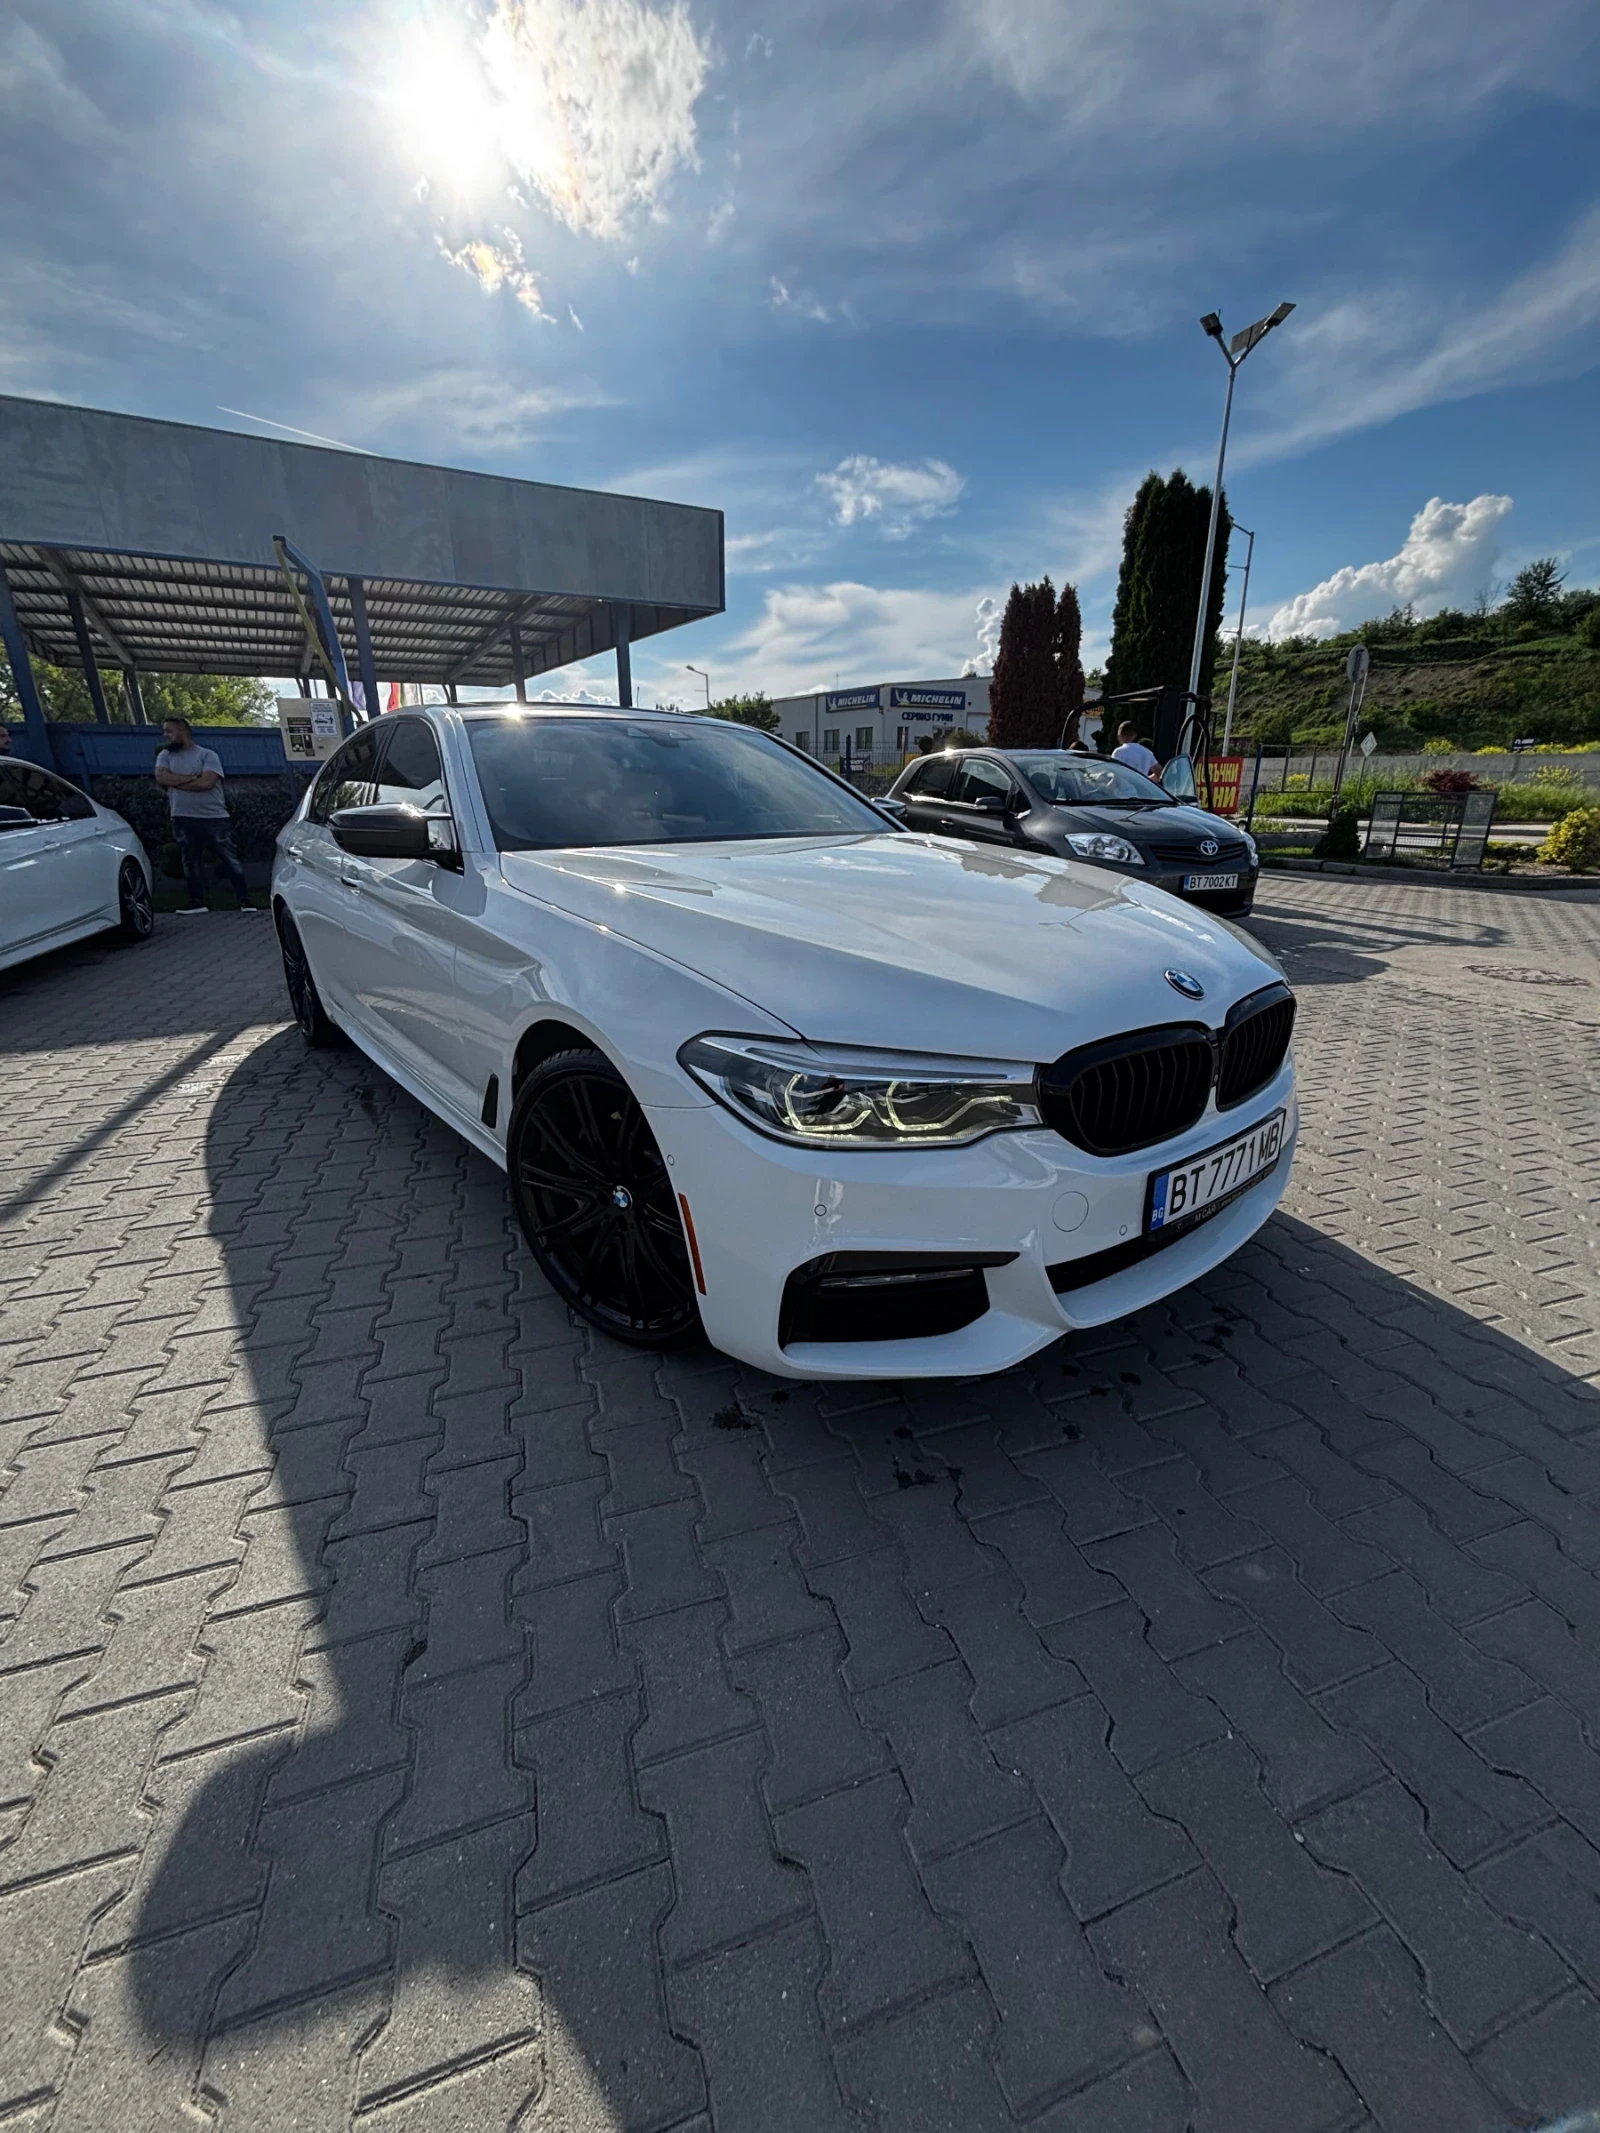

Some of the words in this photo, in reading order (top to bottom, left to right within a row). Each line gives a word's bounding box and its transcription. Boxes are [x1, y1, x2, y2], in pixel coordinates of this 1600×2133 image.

[838, 694, 877, 706] MICHELIN
[910, 694, 963, 705] MICHELIN
[902, 712, 931, 721] СЕРВИЗ
[932, 713, 953, 722] ГУМИ
[1168, 1165, 1206, 1216] BT
[1207, 1136, 1256, 1198] 7771
[1257, 1121, 1280, 1167] MB
[1152, 1207, 1165, 1221] BG
